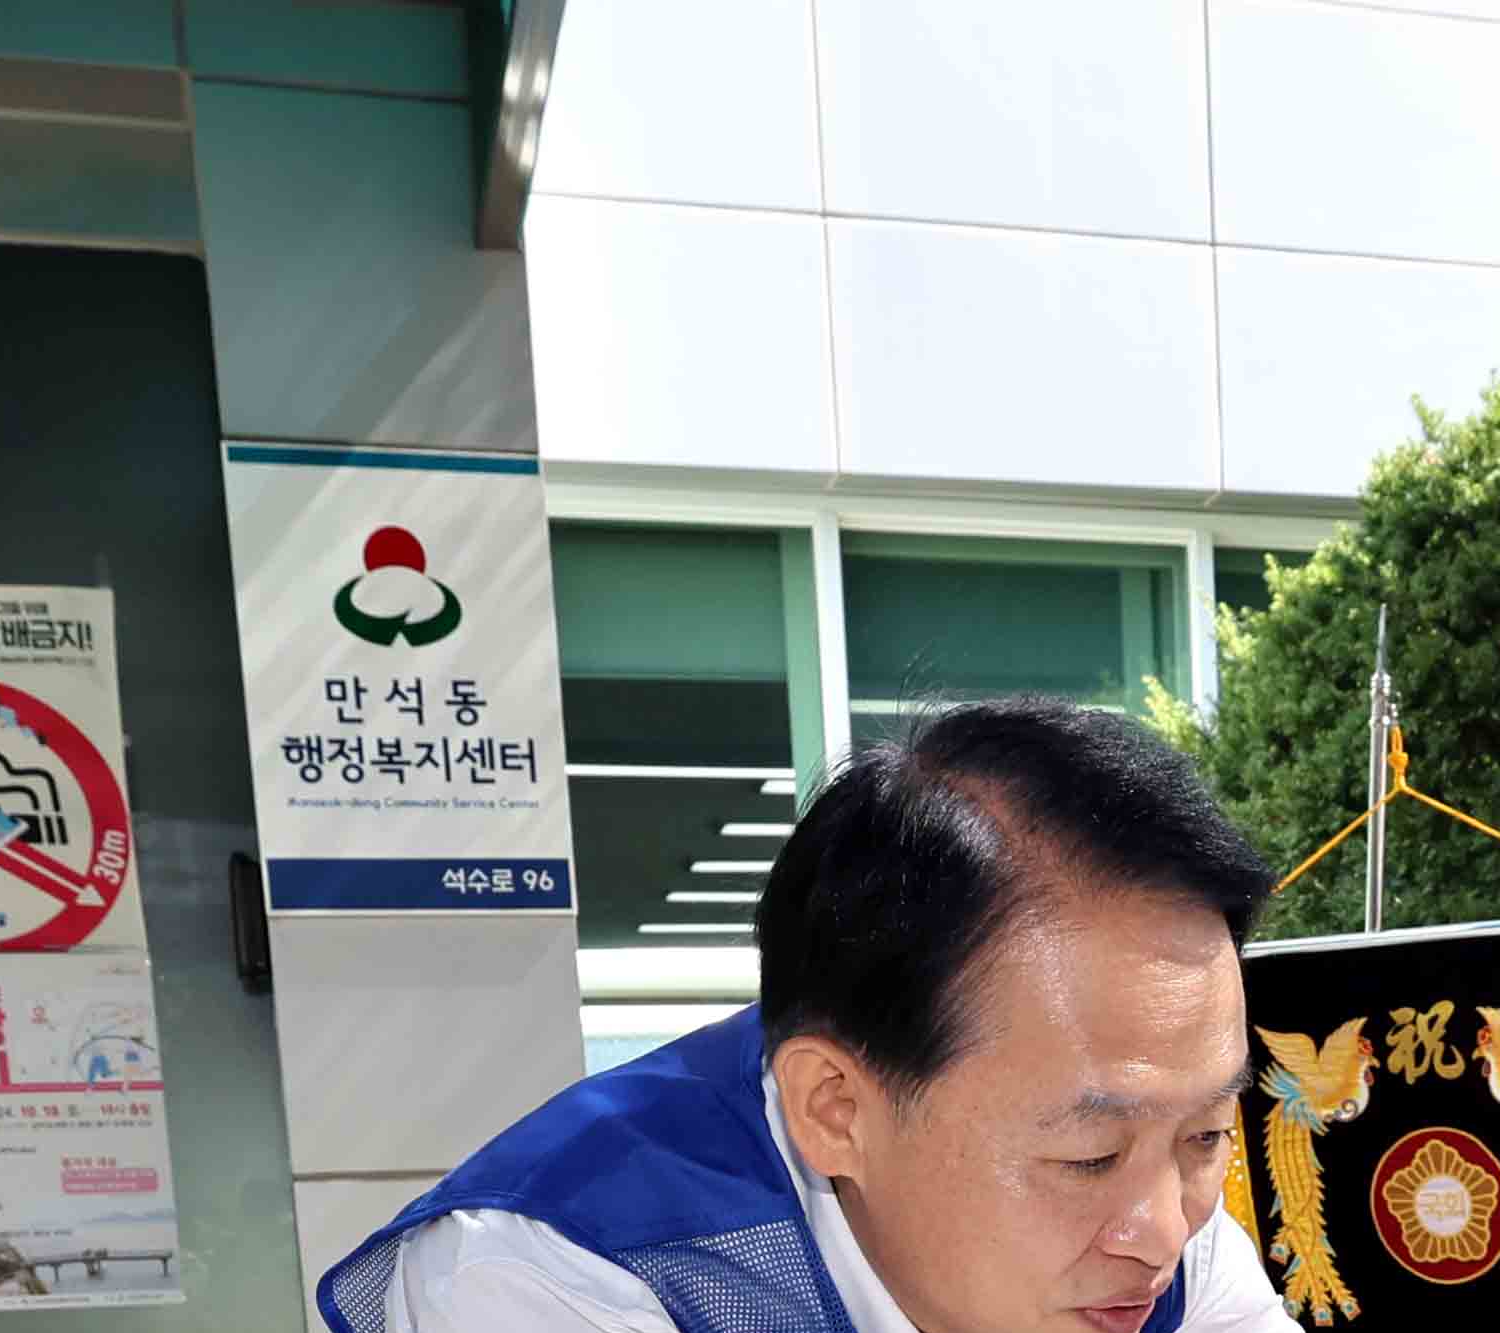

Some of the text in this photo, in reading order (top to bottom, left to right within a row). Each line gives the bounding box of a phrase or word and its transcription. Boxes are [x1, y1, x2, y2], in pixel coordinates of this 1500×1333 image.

[281, 735, 537, 784] 행정복지센터
[384, 797, 448, 810] Community
[452, 797, 496, 809] Service
[499, 798, 540, 809] Center
[92, 830, 126, 885] 30m
[441, 867, 554, 894] 석수로 96
[1386, 1000, 1465, 1085] 祝
